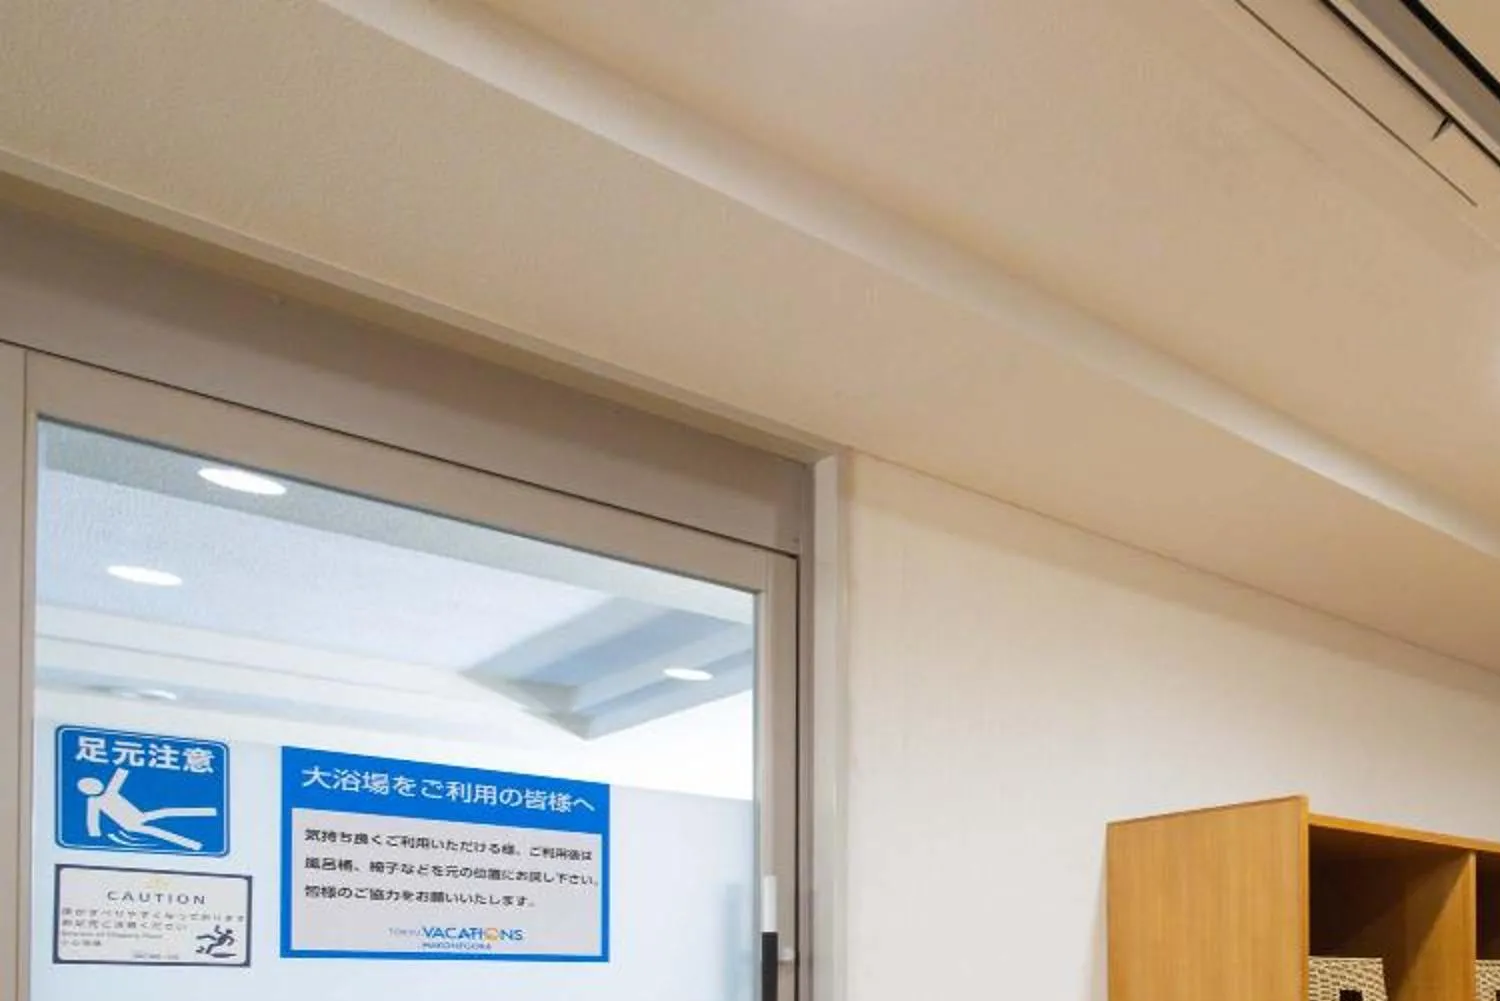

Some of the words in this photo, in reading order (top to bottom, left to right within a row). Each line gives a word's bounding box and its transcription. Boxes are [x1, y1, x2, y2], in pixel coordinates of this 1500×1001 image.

[75, 735, 214, 774] 足元注意
[301, 764, 595, 812] 大浴場をご利用の皆様へ
[107, 890, 206, 905] CAUTION
[421, 926, 524, 941] VACATIONS
